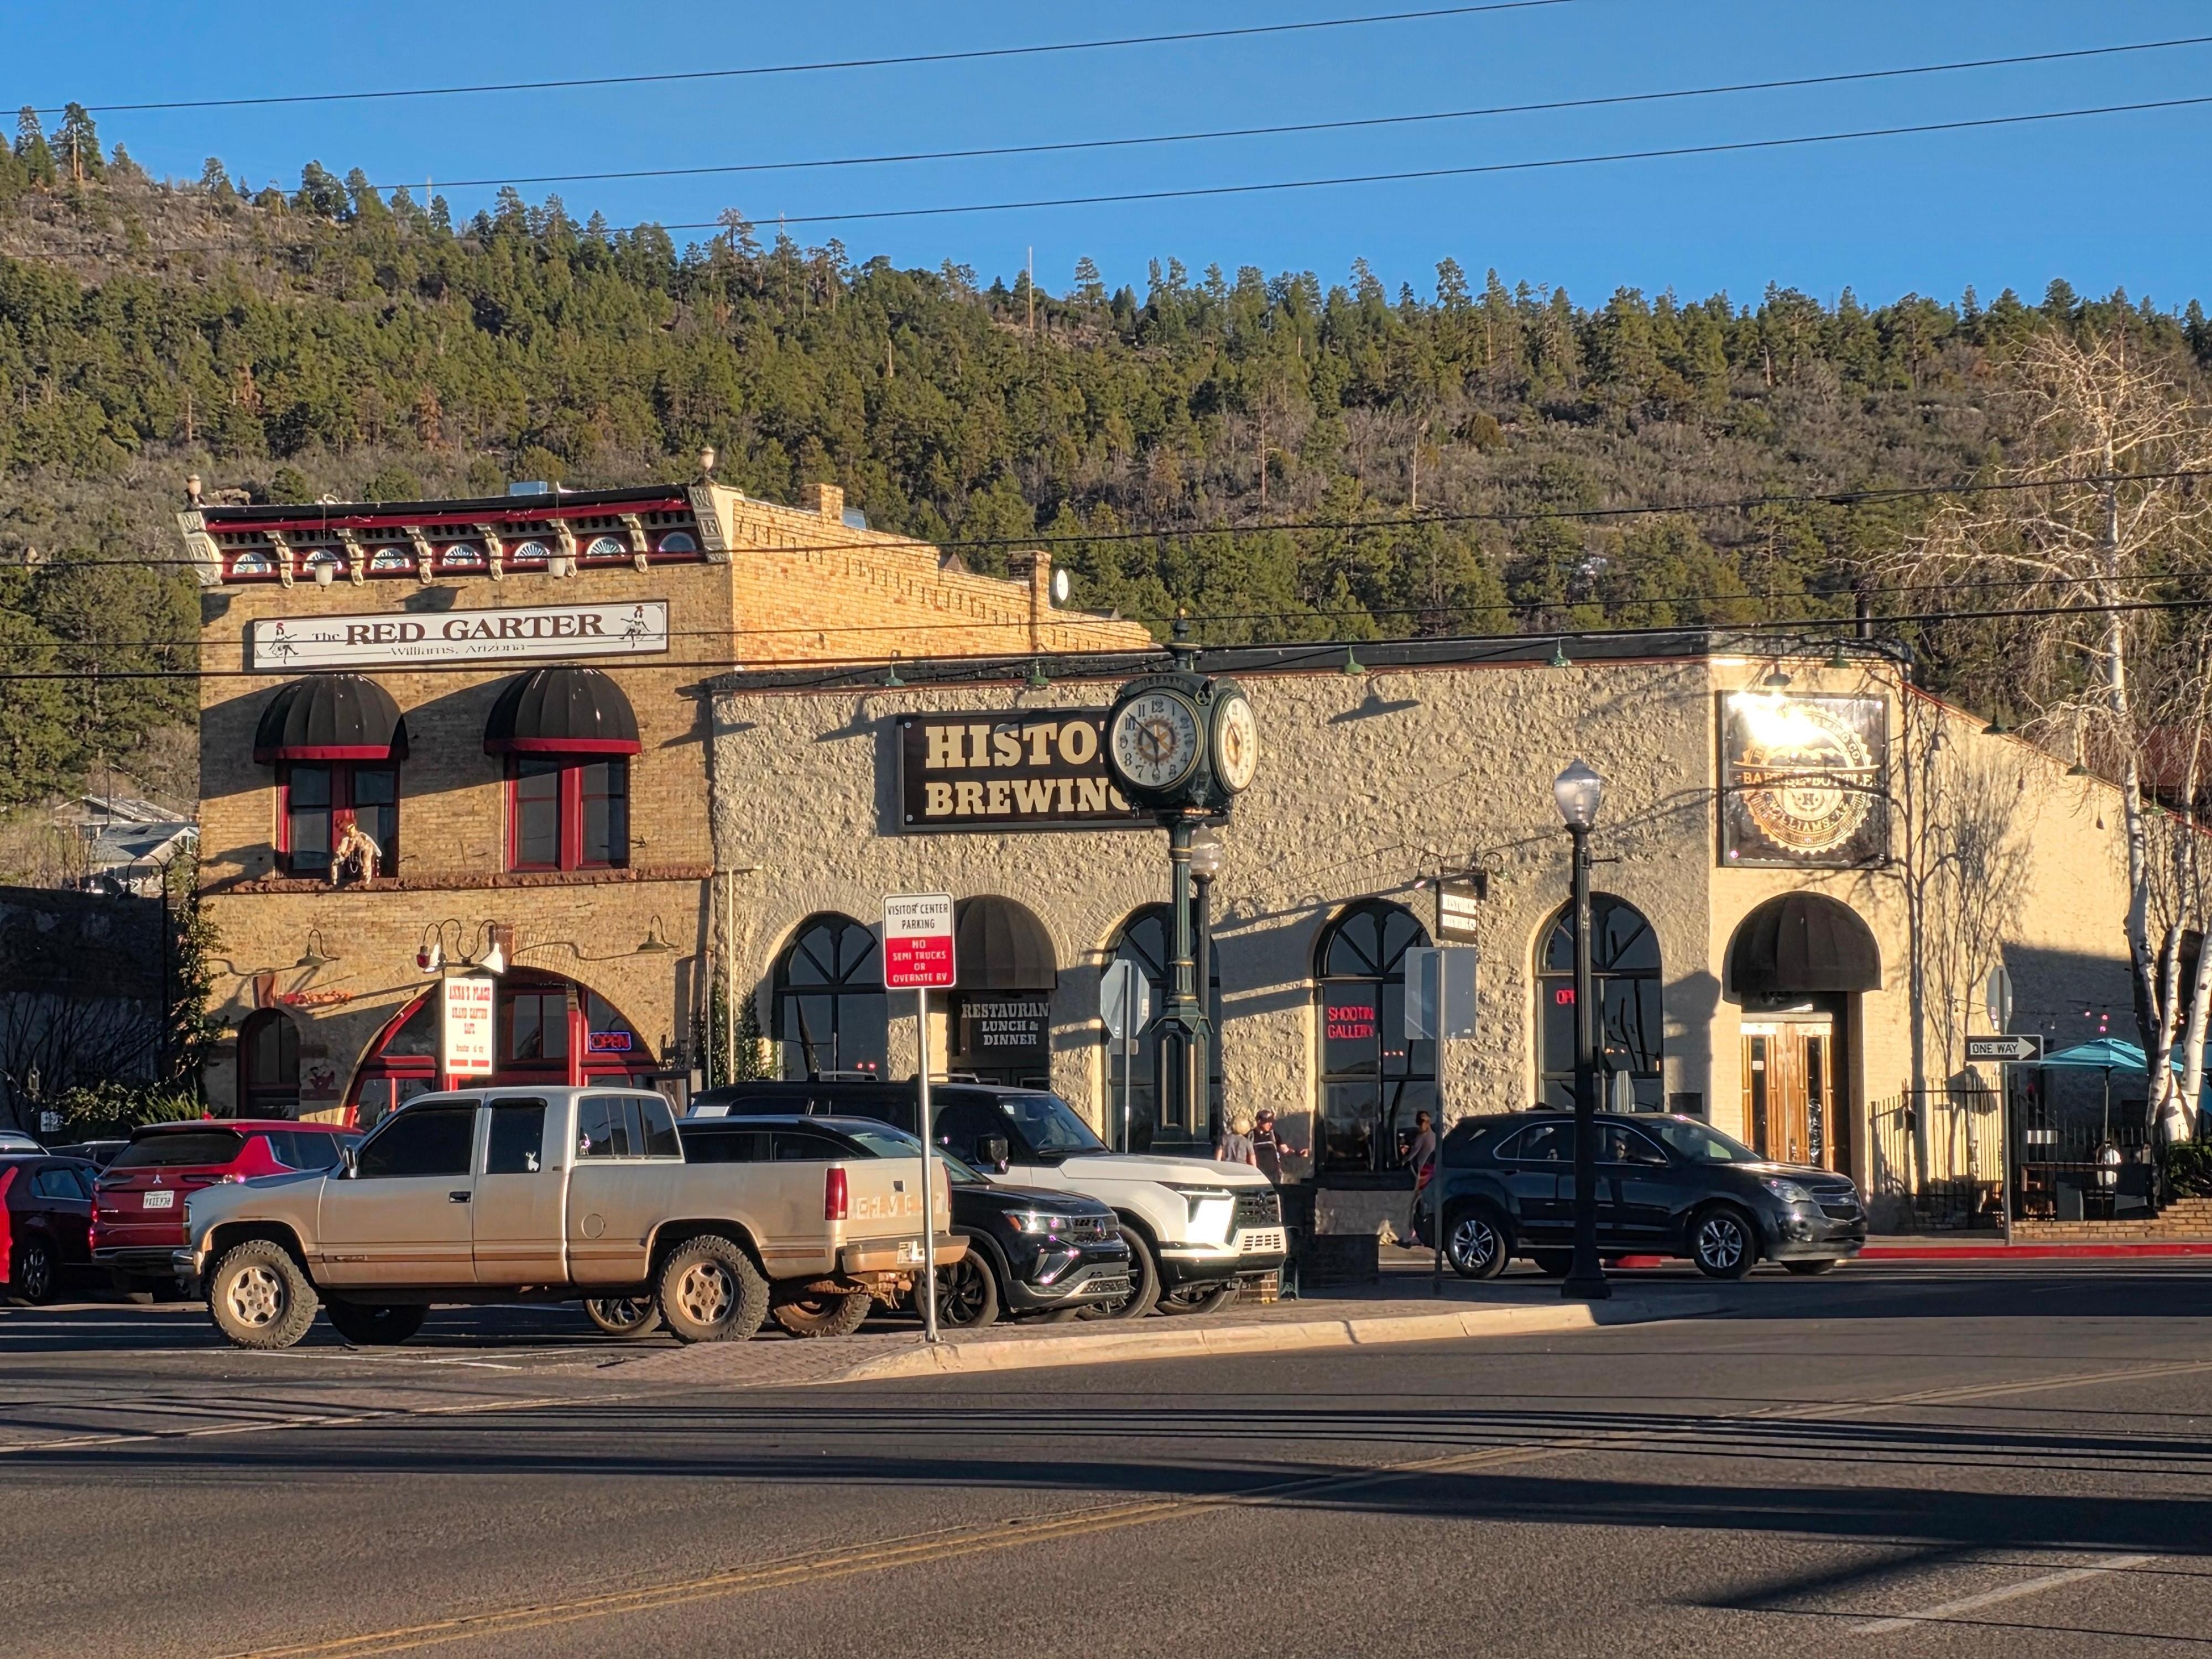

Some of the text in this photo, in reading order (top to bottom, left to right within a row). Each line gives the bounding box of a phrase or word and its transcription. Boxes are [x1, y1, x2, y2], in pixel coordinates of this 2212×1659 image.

[312, 614, 605, 646] The RED GARTER
[391, 644, 525, 656] Williams, Arizona
[1138, 704, 1145, 717] 11
[1151, 700, 1164, 713] 12
[926, 721, 1105, 768] HISTO
[1124, 753, 1132, 766] 8
[1180, 752, 1188, 764] 4
[1135, 765, 1145, 780] 7
[1744, 772, 1806, 785] BAR
[887, 903, 948, 915] VISITOR CENTER
[902, 919, 935, 929] PARKING
[912, 940, 926, 949] NO
[893, 951, 946, 961] SEMI TRUCKS
[936, 973, 947, 981] RV
[982, 1020, 1039, 1032] LUNCH &
[1328, 1024, 1374, 1039] GALLERY
[592, 1035, 629, 1048] OPEN
[984, 1034, 1036, 1046] DINNER
[1972, 1044, 2018, 1053] ONE WAY
